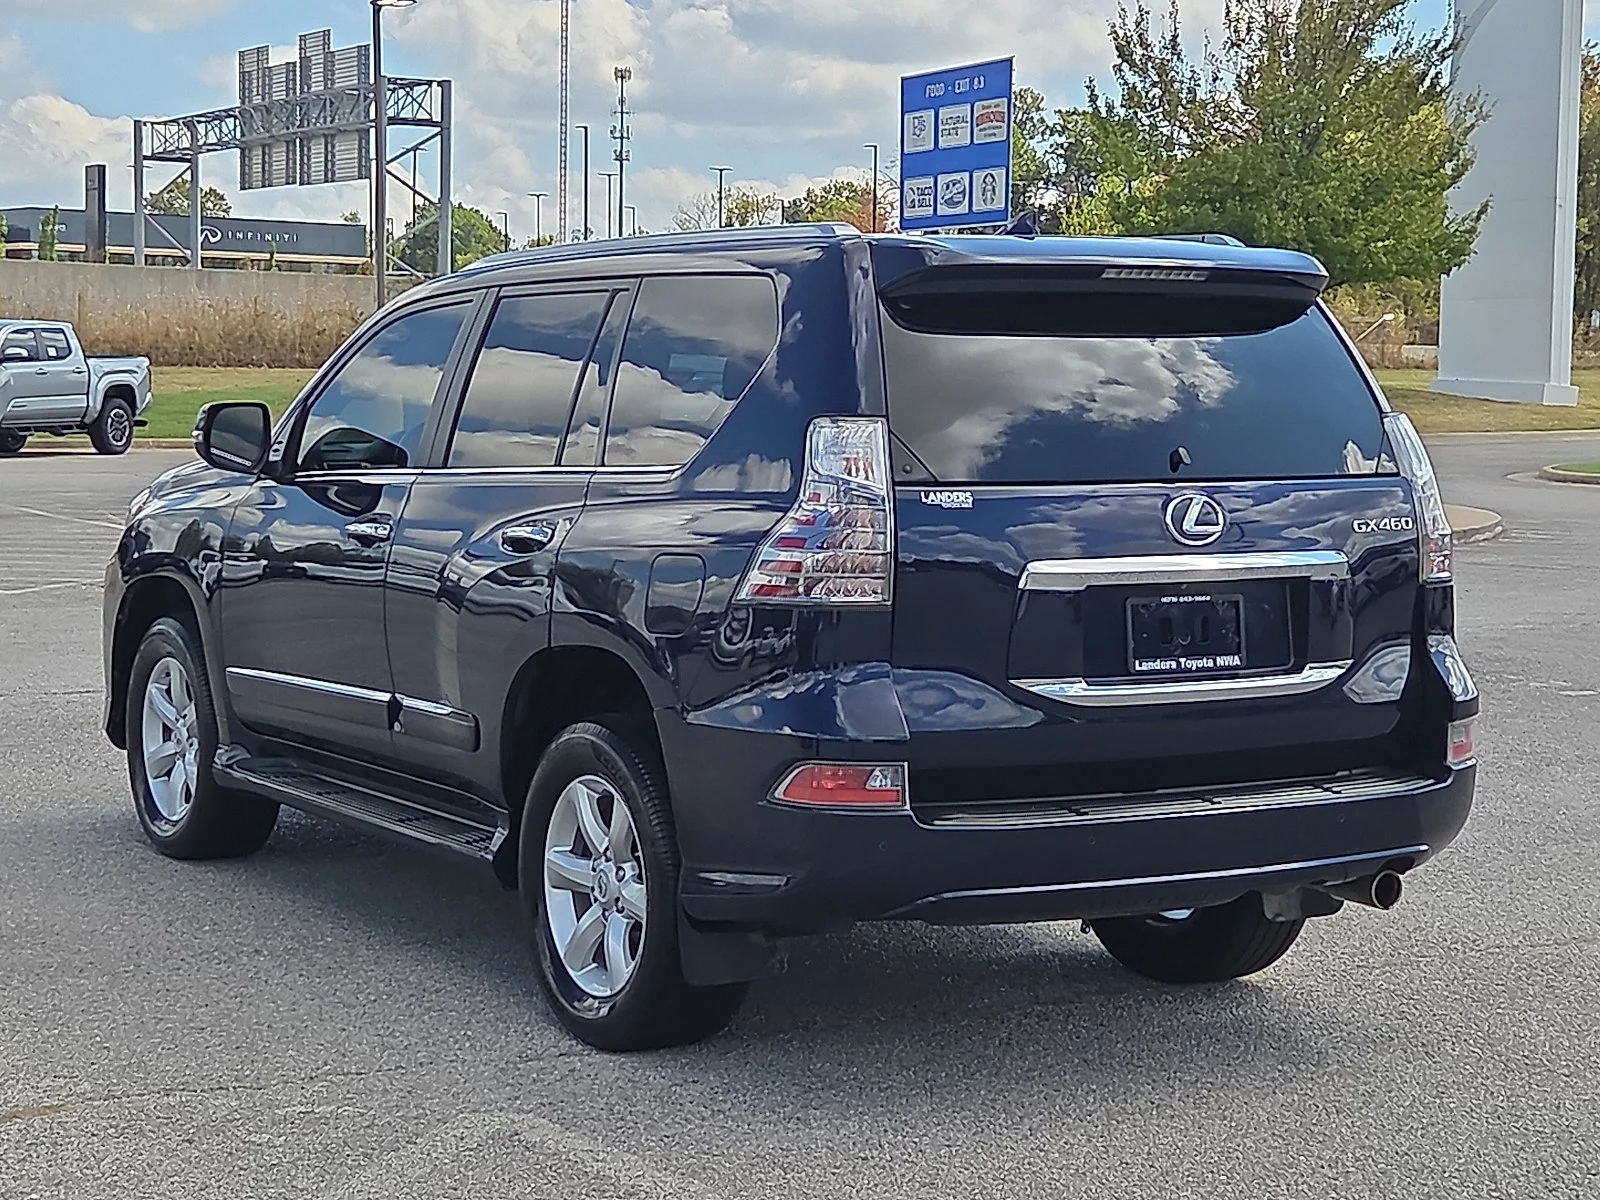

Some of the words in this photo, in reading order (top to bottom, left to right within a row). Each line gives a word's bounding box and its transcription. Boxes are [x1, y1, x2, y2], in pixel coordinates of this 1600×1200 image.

[925, 82, 945, 98] FOOD
[954, 78, 970, 93] EXIT
[916, 186, 933, 196] TACO
[917, 197, 932, 208] BELL
[227, 230, 298, 242] INFINITI
[920, 491, 973, 504] LANDERS
[1135, 658, 1177, 671] Landers
[1179, 657, 1214, 670] Toyota
[1216, 655, 1241, 667] NWA
